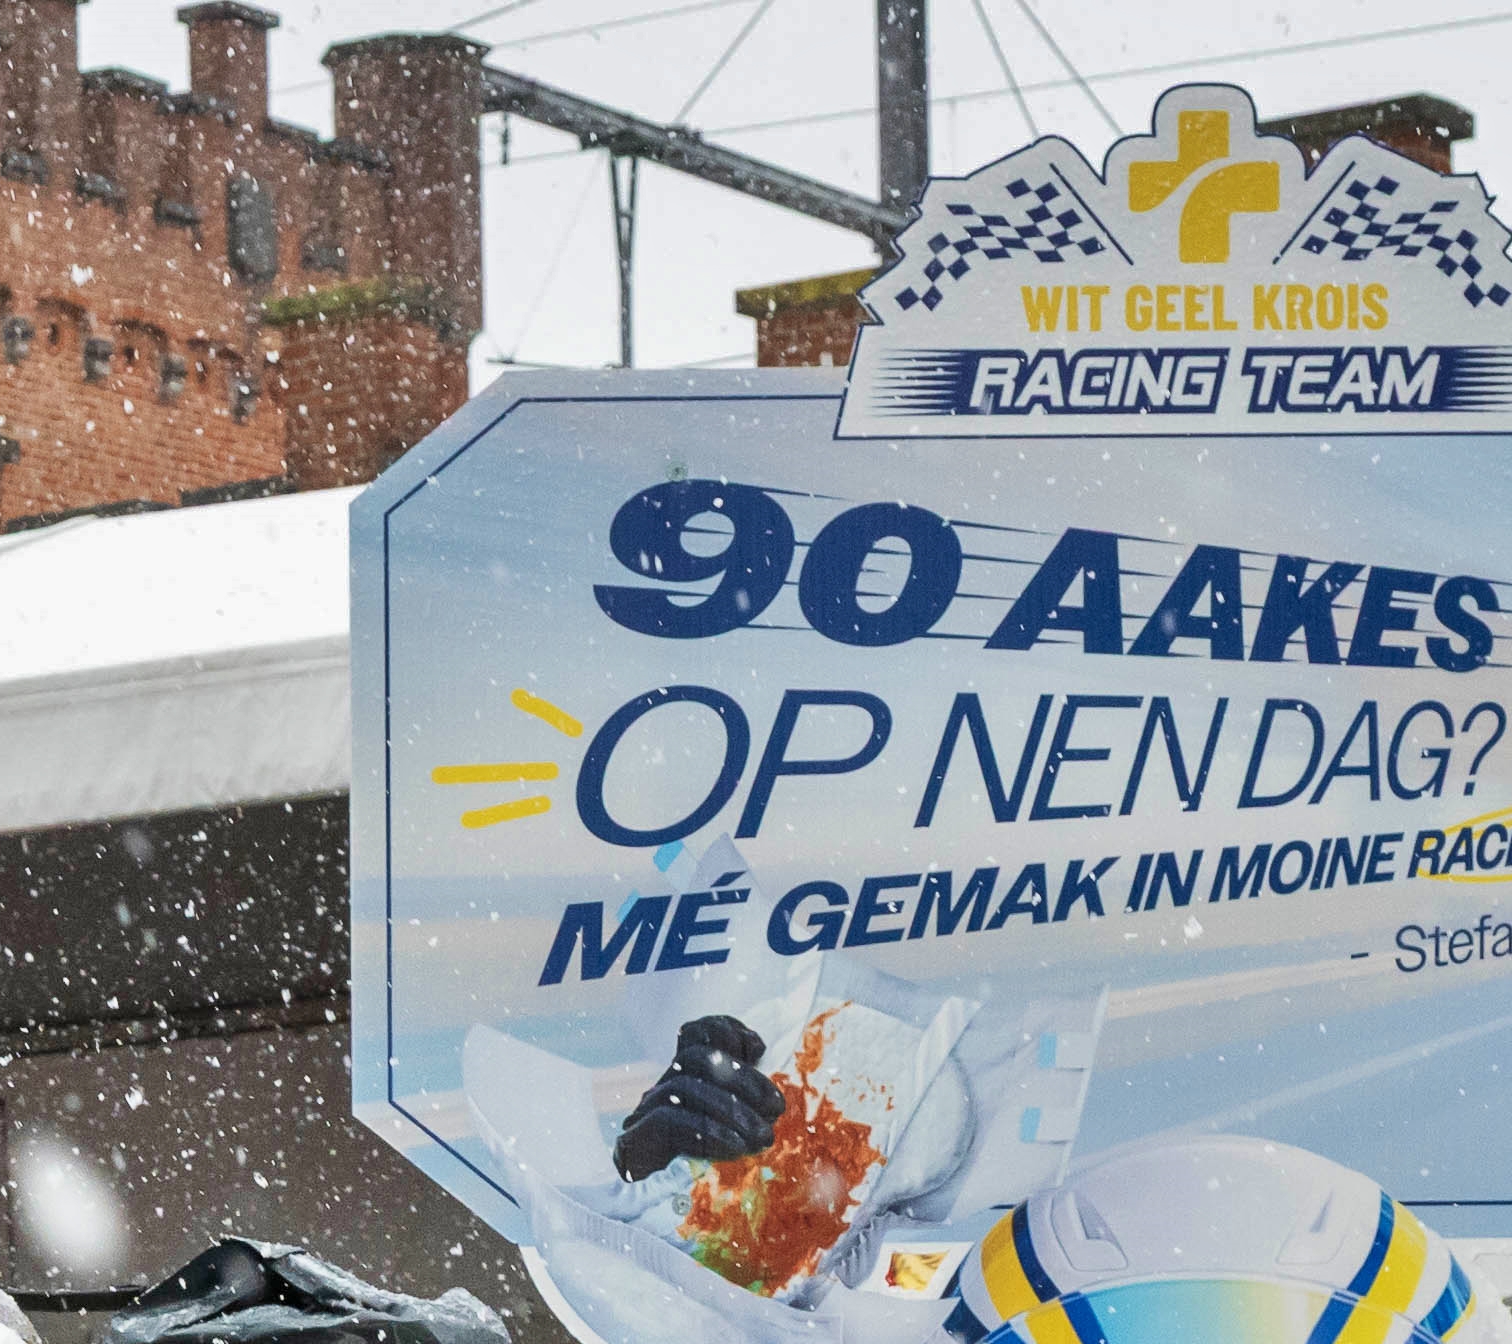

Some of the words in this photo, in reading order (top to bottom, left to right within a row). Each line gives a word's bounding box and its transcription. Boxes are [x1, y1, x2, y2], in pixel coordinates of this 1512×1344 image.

[969, 354, 1220, 408] RACING
[1247, 354, 1441, 407] TEAM
[1021, 285, 1109, 332] WIT
[1125, 285, 1238, 332] GEEL
[1252, 283, 1390, 331] KROIS
[593, 481, 964, 648] 90
[986, 524, 1501, 673] AAKES
[574, 683, 893, 848] OP
[914, 692, 1232, 828] NEN
[1240, 698, 1503, 806] DAG?
[538, 871, 751, 986] MÉ
[767, 856, 1119, 956] GEMAK
[1124, 851, 1202, 914] IN
[1209, 833, 1404, 903] MOINE
